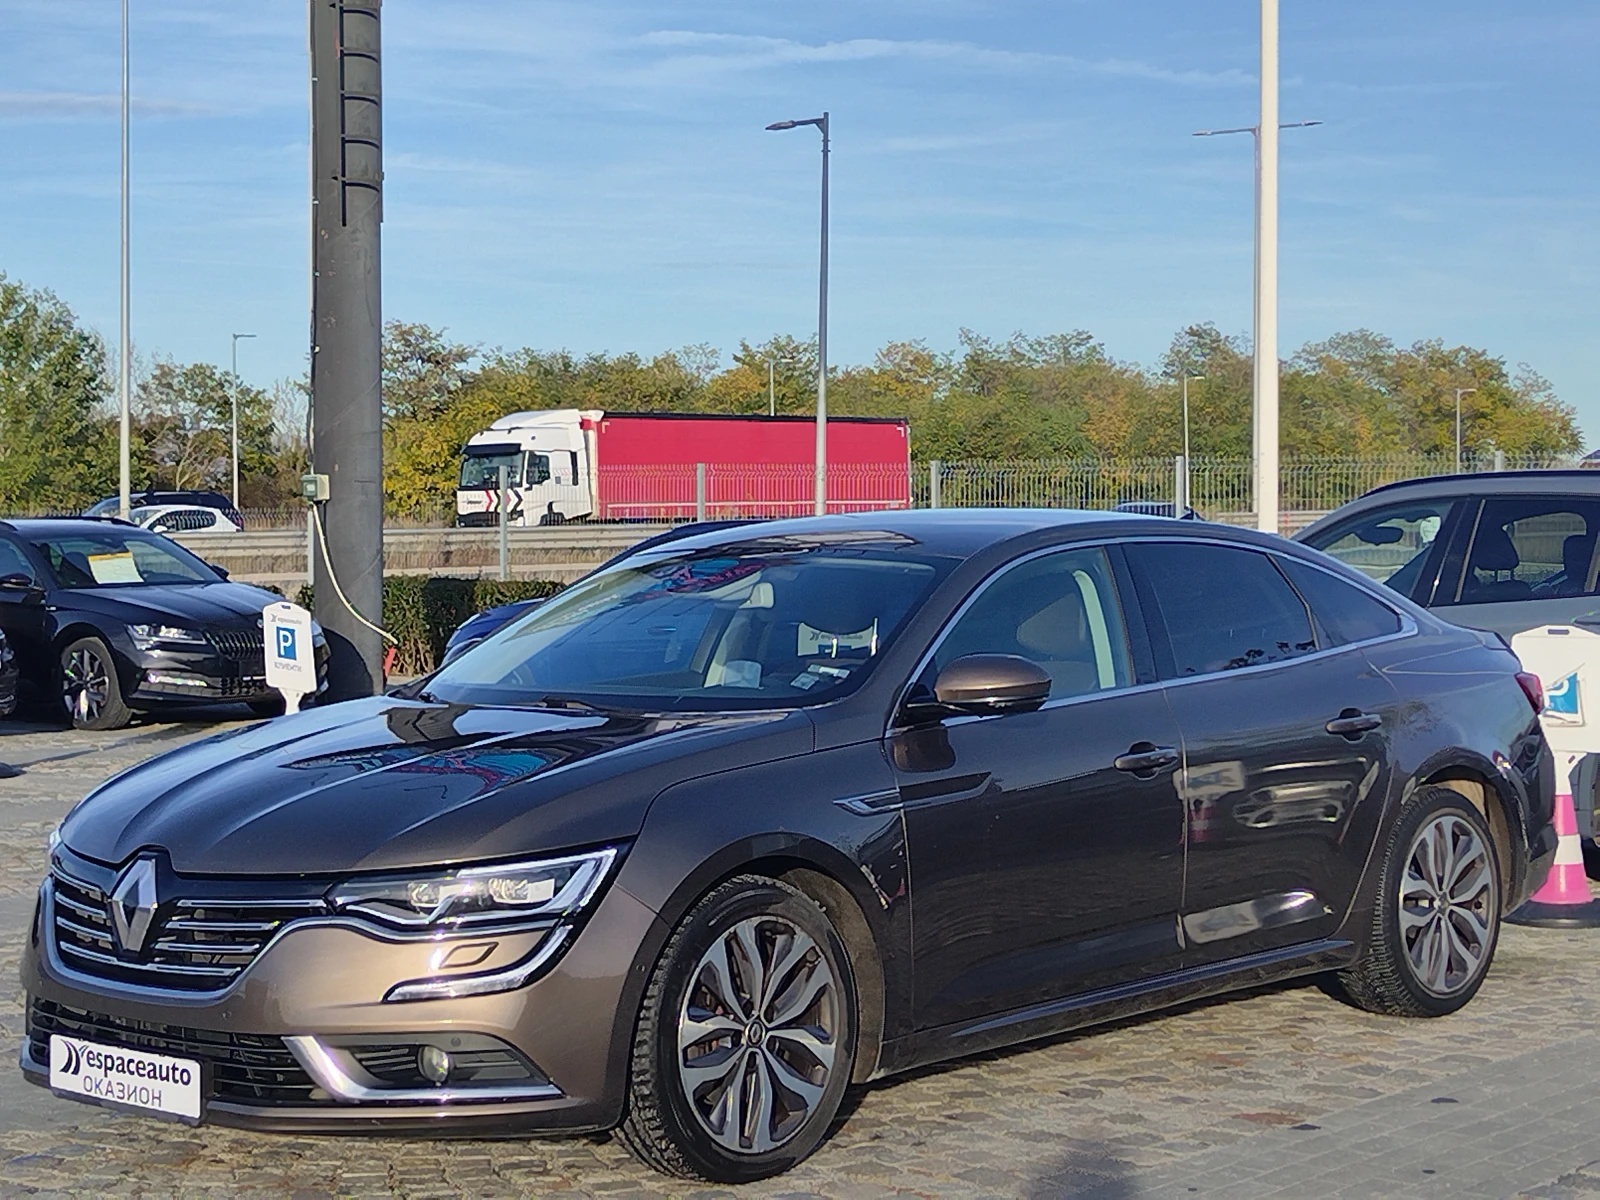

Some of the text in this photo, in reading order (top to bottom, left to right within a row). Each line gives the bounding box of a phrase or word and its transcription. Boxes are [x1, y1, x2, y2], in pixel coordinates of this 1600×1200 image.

[279, 630, 292, 656] P
[86, 1050, 191, 1085] espaceauto
[83, 1076, 162, 1107] ОКАЗИОН
